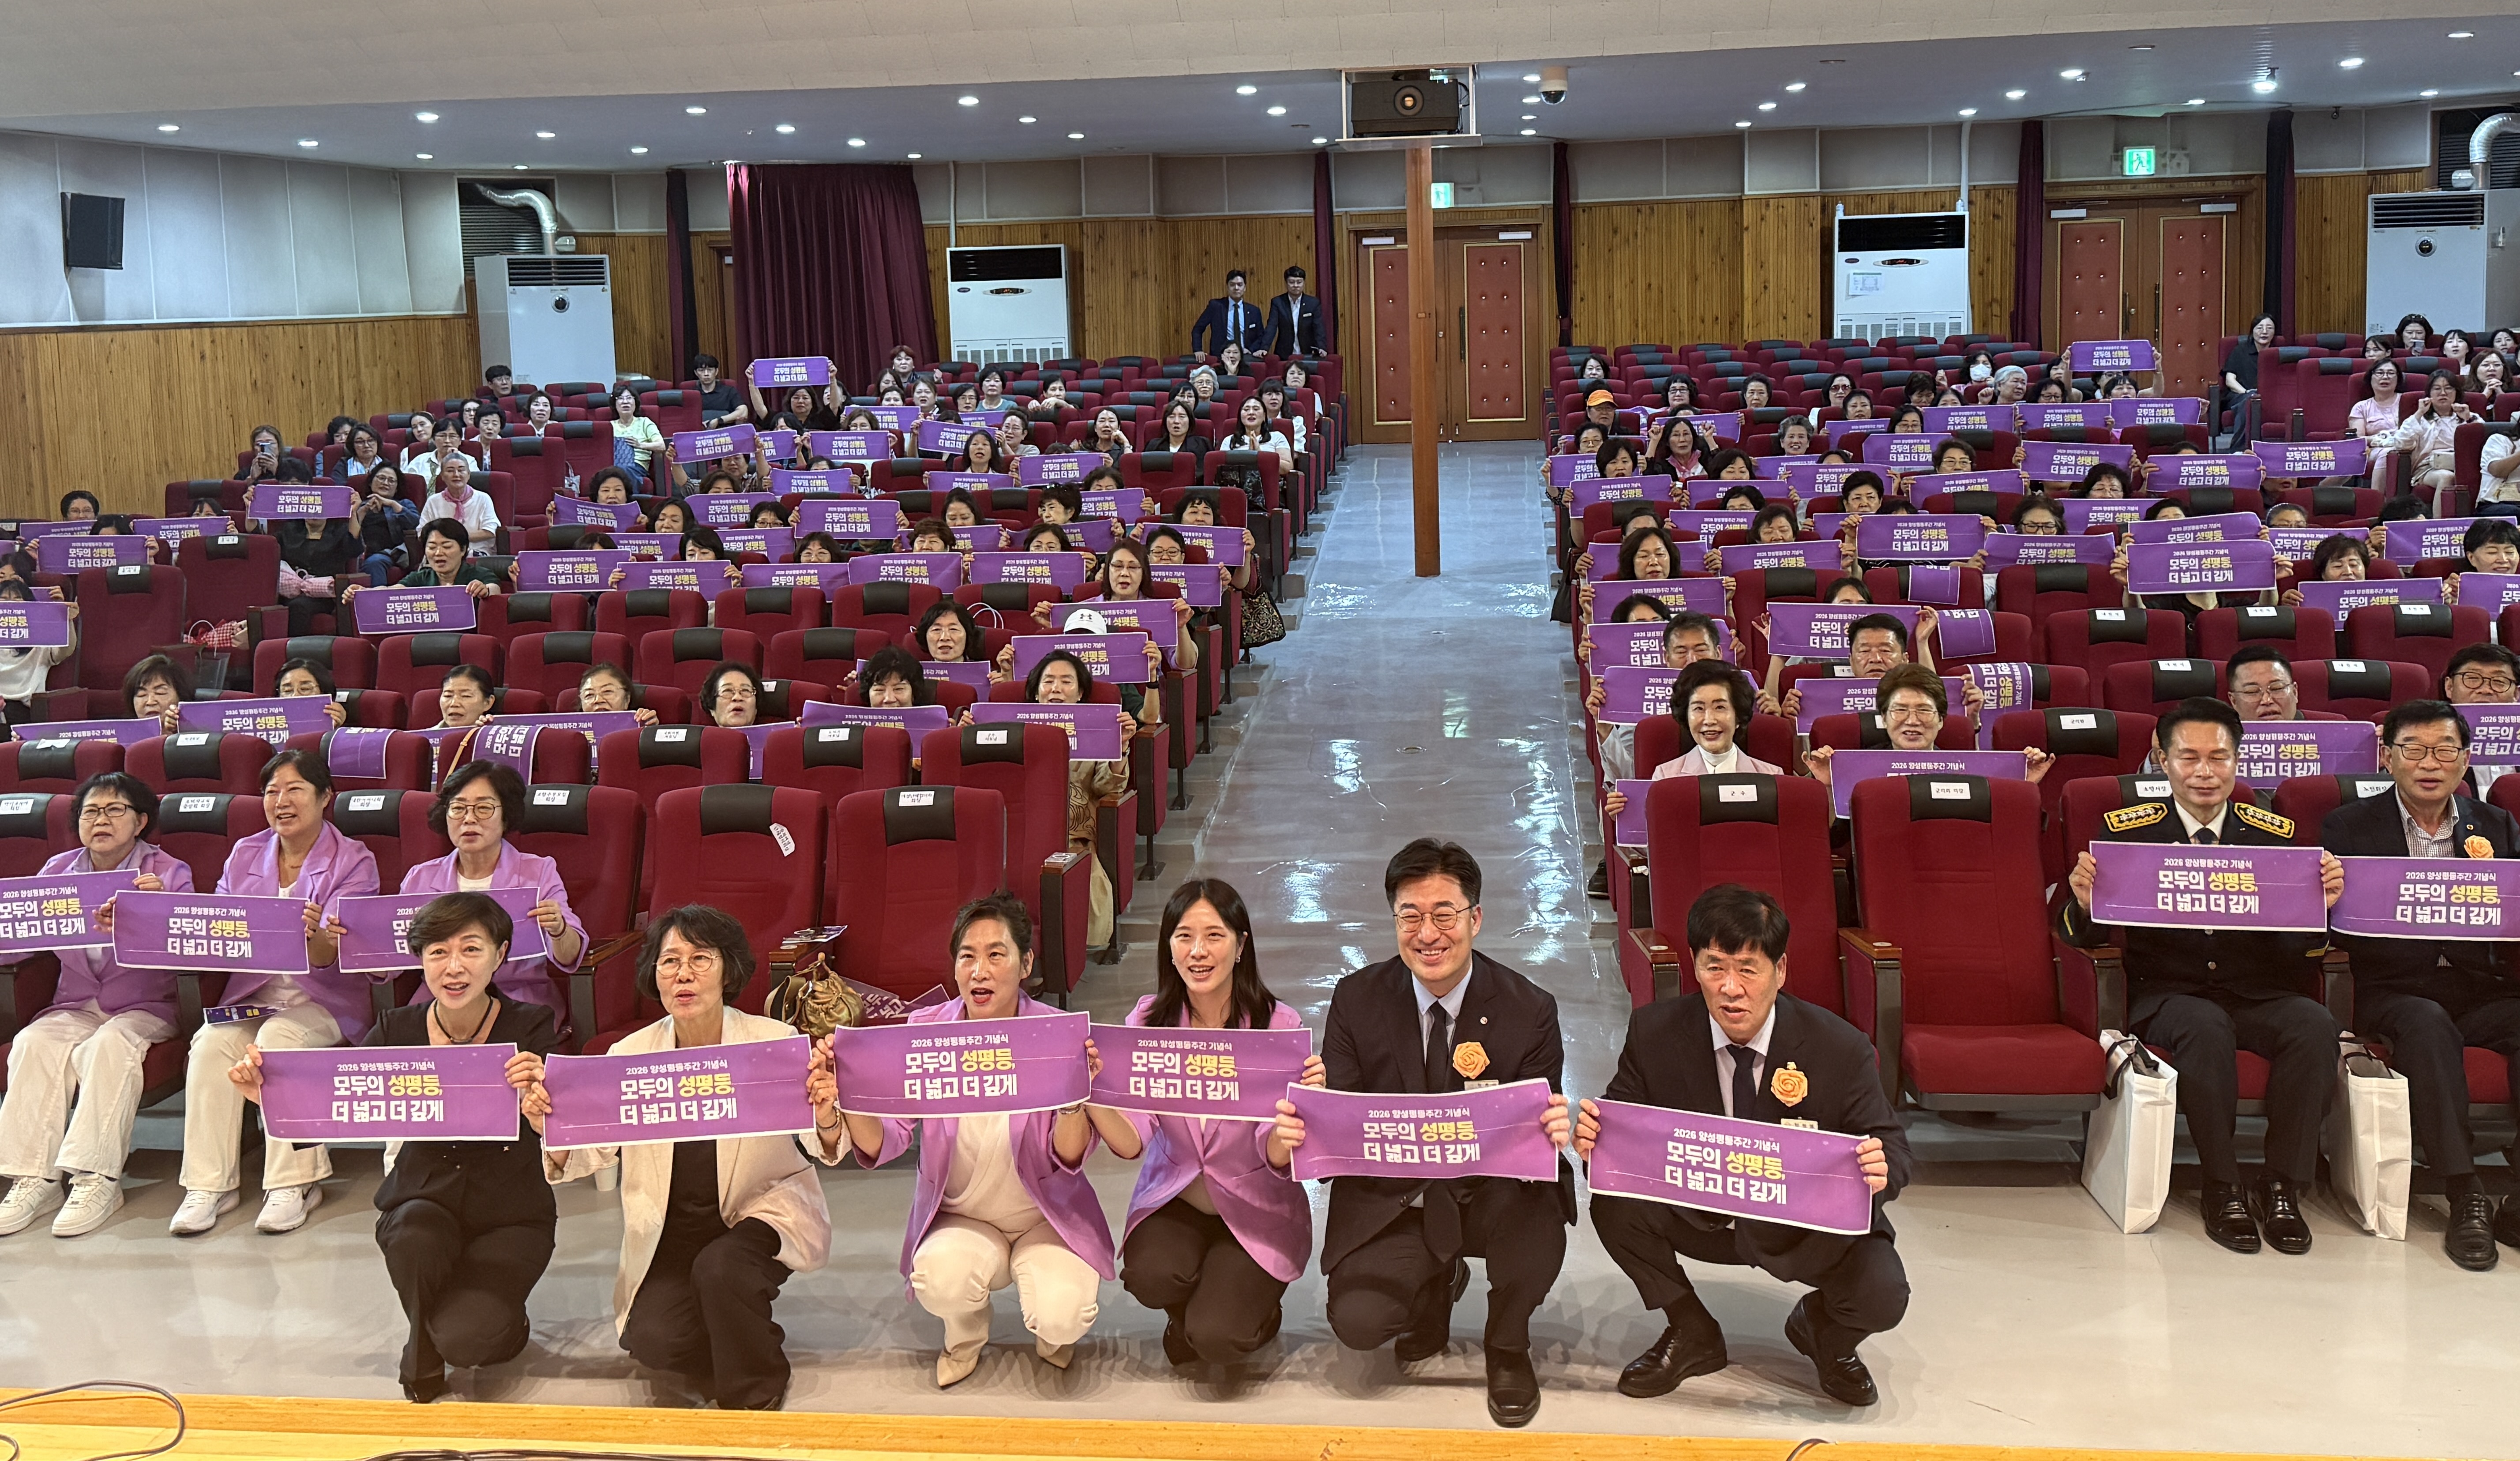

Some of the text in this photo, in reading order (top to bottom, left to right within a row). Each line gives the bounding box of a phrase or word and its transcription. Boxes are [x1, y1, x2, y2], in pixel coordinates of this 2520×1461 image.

[222, 717, 253, 730] 모두의
[2474, 727, 2513, 740] 모두의
[2238, 744, 2275, 759] 모두의
[2470, 743, 2482, 755] 더
[2236, 762, 2321, 777] 더 넓고 더 깊게
[2159, 870, 2205, 890] 모두의
[2399, 884, 2445, 902] 모두의
[0, 901, 38, 919] 모두의
[2157, 893, 2259, 914] 더 넓고 더 깊게
[2396, 905, 2501, 925] 더 넓고 더 깊게
[0, 917, 85, 939] 더 넓고 더 깊게
[169, 918, 206, 936] 모두의
[168, 938, 252, 958] 더 넓고 더 깊게
[935, 1036, 982, 1047] 양성평등주간
[984, 1034, 1008, 1044] 기념식
[1160, 1040, 1206, 1050] 양성평등주간
[1209, 1042, 1232, 1052] 기념식
[360, 1062, 409, 1071] 양성평등주간
[410, 1061, 435, 1070] 기념식
[626, 1059, 728, 1075] 2026 양성평등주간 기념식
[906, 1052, 956, 1074] 모두의
[1131, 1052, 1180, 1074] 모두의
[333, 1075, 384, 1096] 모두의
[621, 1077, 673, 1100] 모두의
[905, 1074, 1017, 1100] 더 넓고 더 깊게
[1130, 1077, 1239, 1100] 더 넓고 더 깊게
[332, 1100, 443, 1123] 더 넓고 더 깊게
[620, 1098, 737, 1125] 더 넓고 더 깊게
[1368, 1108, 1470, 1119] 2026 양성평등주간 기념식
[1363, 1123, 1416, 1141] 모두의
[1674, 1128, 1780, 1153] 2026 양성평등주간 기념식
[1363, 1142, 1480, 1164] 더 넓고 더 깊게
[1667, 1141, 1721, 1170] 모두의
[1665, 1165, 1786, 1204] 더 넓고 더 깊게
